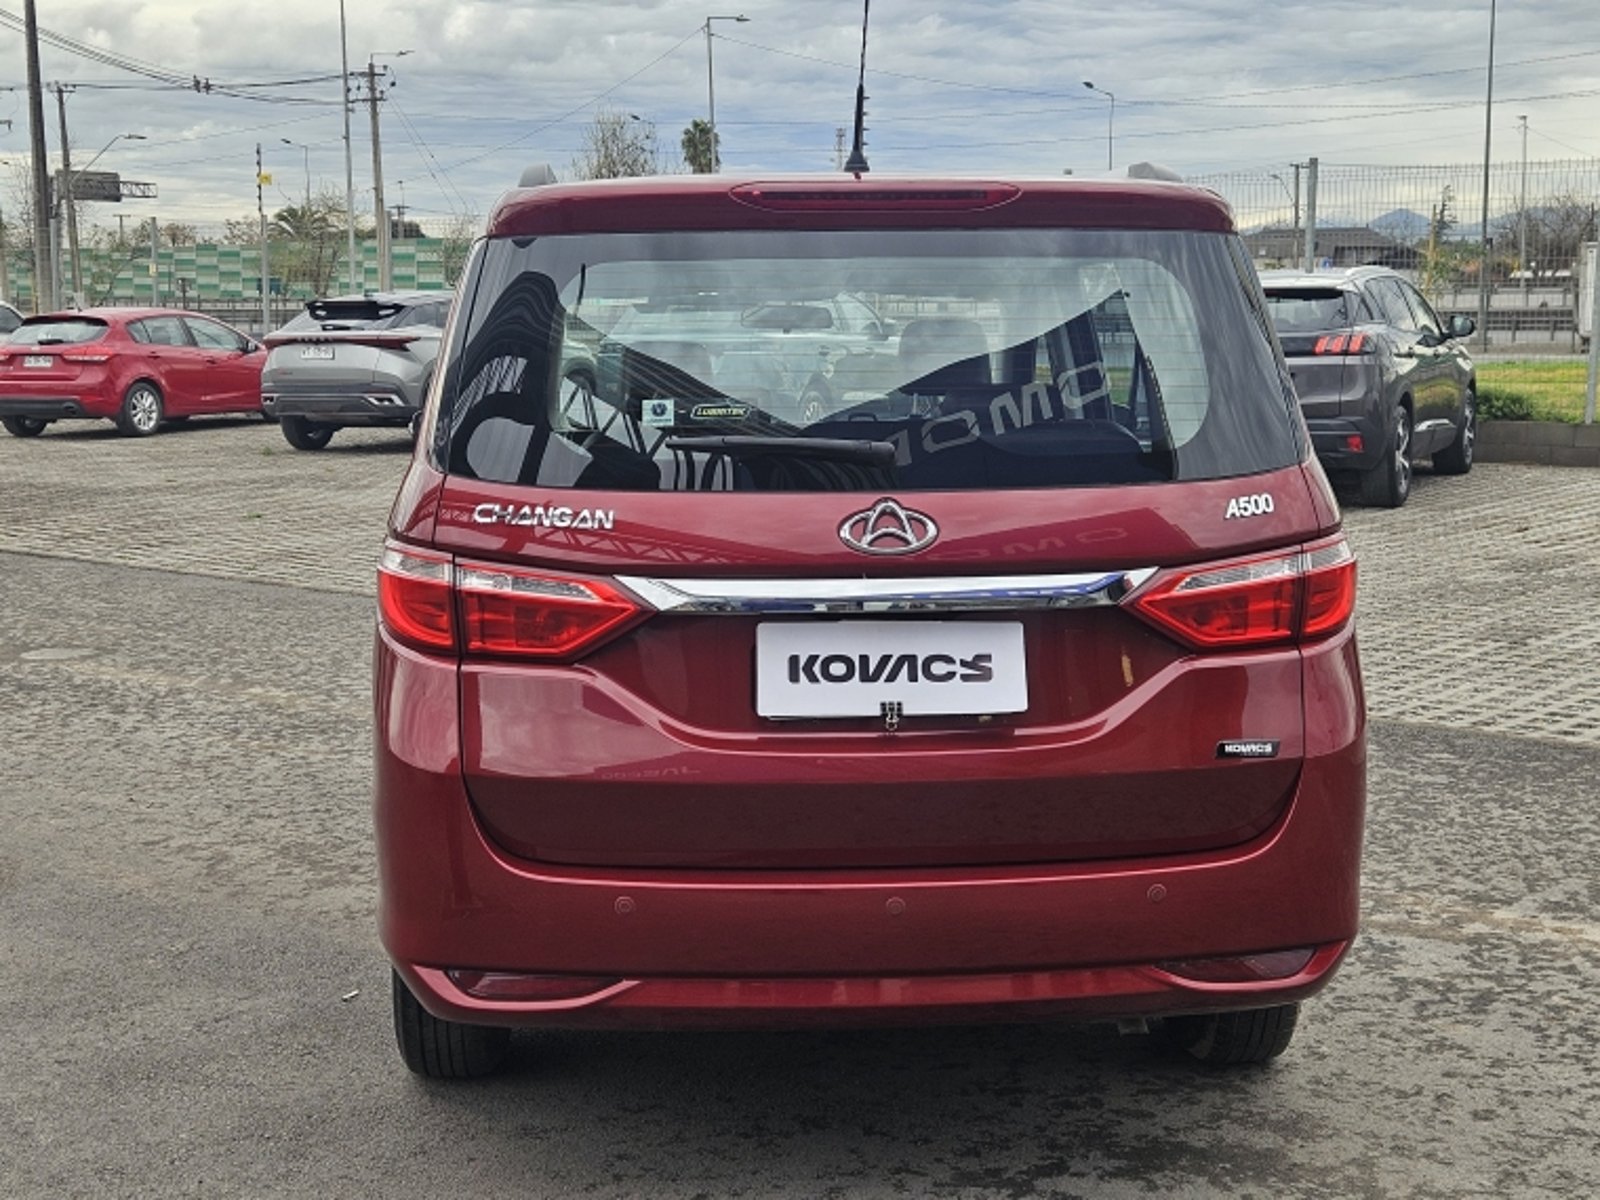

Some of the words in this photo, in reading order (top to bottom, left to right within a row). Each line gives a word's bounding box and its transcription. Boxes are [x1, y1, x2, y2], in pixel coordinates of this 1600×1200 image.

[474, 503, 614, 529] CHANGAN
[1224, 493, 1275, 519] A500
[787, 653, 993, 684] KOVACS
[1224, 743, 1273, 753] KOVACS
